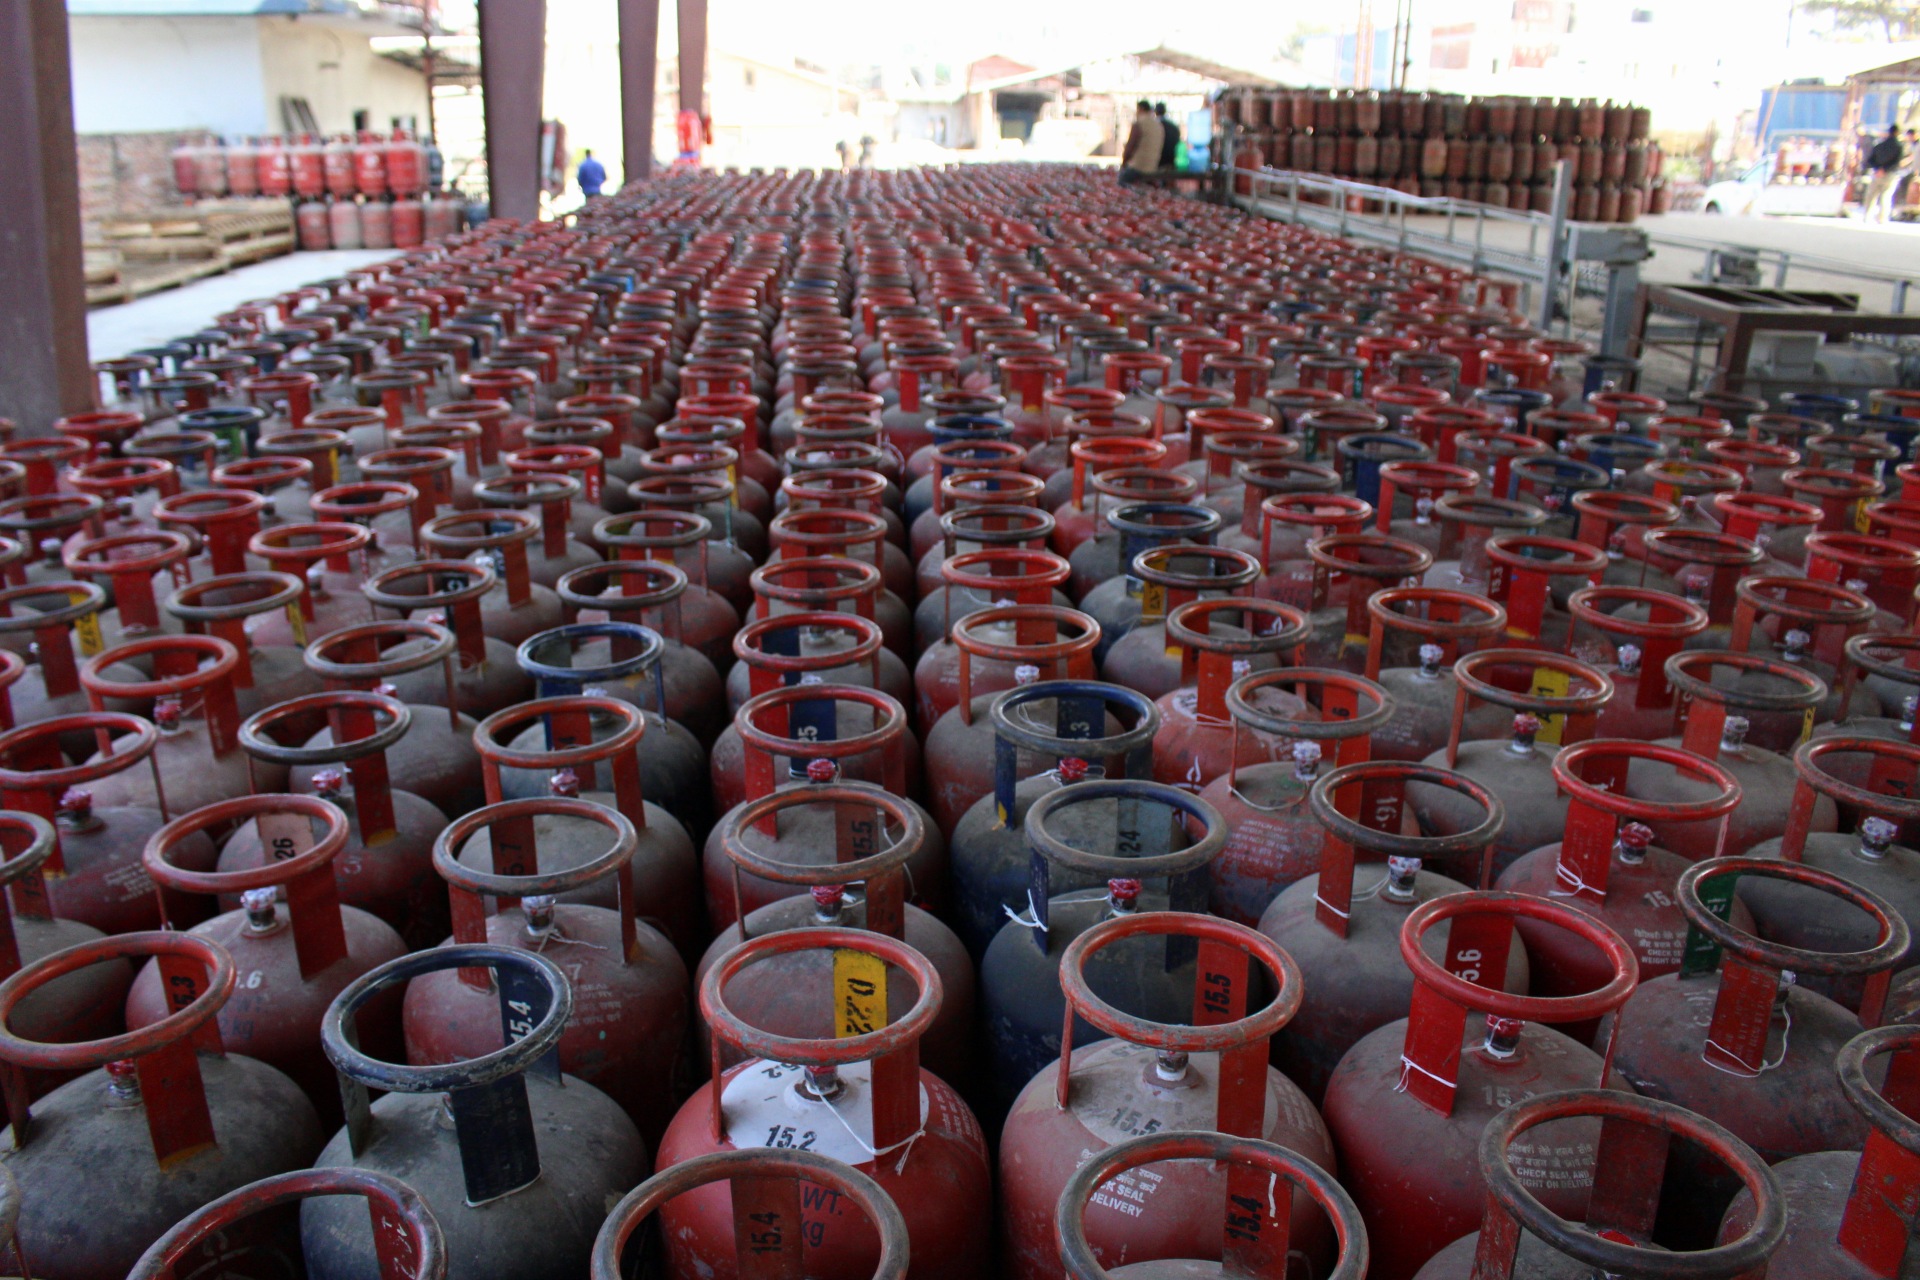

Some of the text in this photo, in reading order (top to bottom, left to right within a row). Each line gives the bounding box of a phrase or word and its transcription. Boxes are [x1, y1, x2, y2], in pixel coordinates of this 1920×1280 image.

[272, 838, 295, 860] 26
[1644, 890, 1679, 908] 15.
[1455, 949, 1482, 981] 5.6
[1203, 972, 1231, 1014] 15.5
[766, 1125, 817, 1152] 15.2
[1516, 1167, 1548, 1178] CHECK
[1519, 1178, 1595, 1189] EIGHT ON DELIVER
[803, 1186, 843, 1216] WT.
[1117, 1184, 1145, 1204] SEAL
[1226, 1194, 1263, 1242] 15.4
[749, 1211, 782, 1255] 15.4
